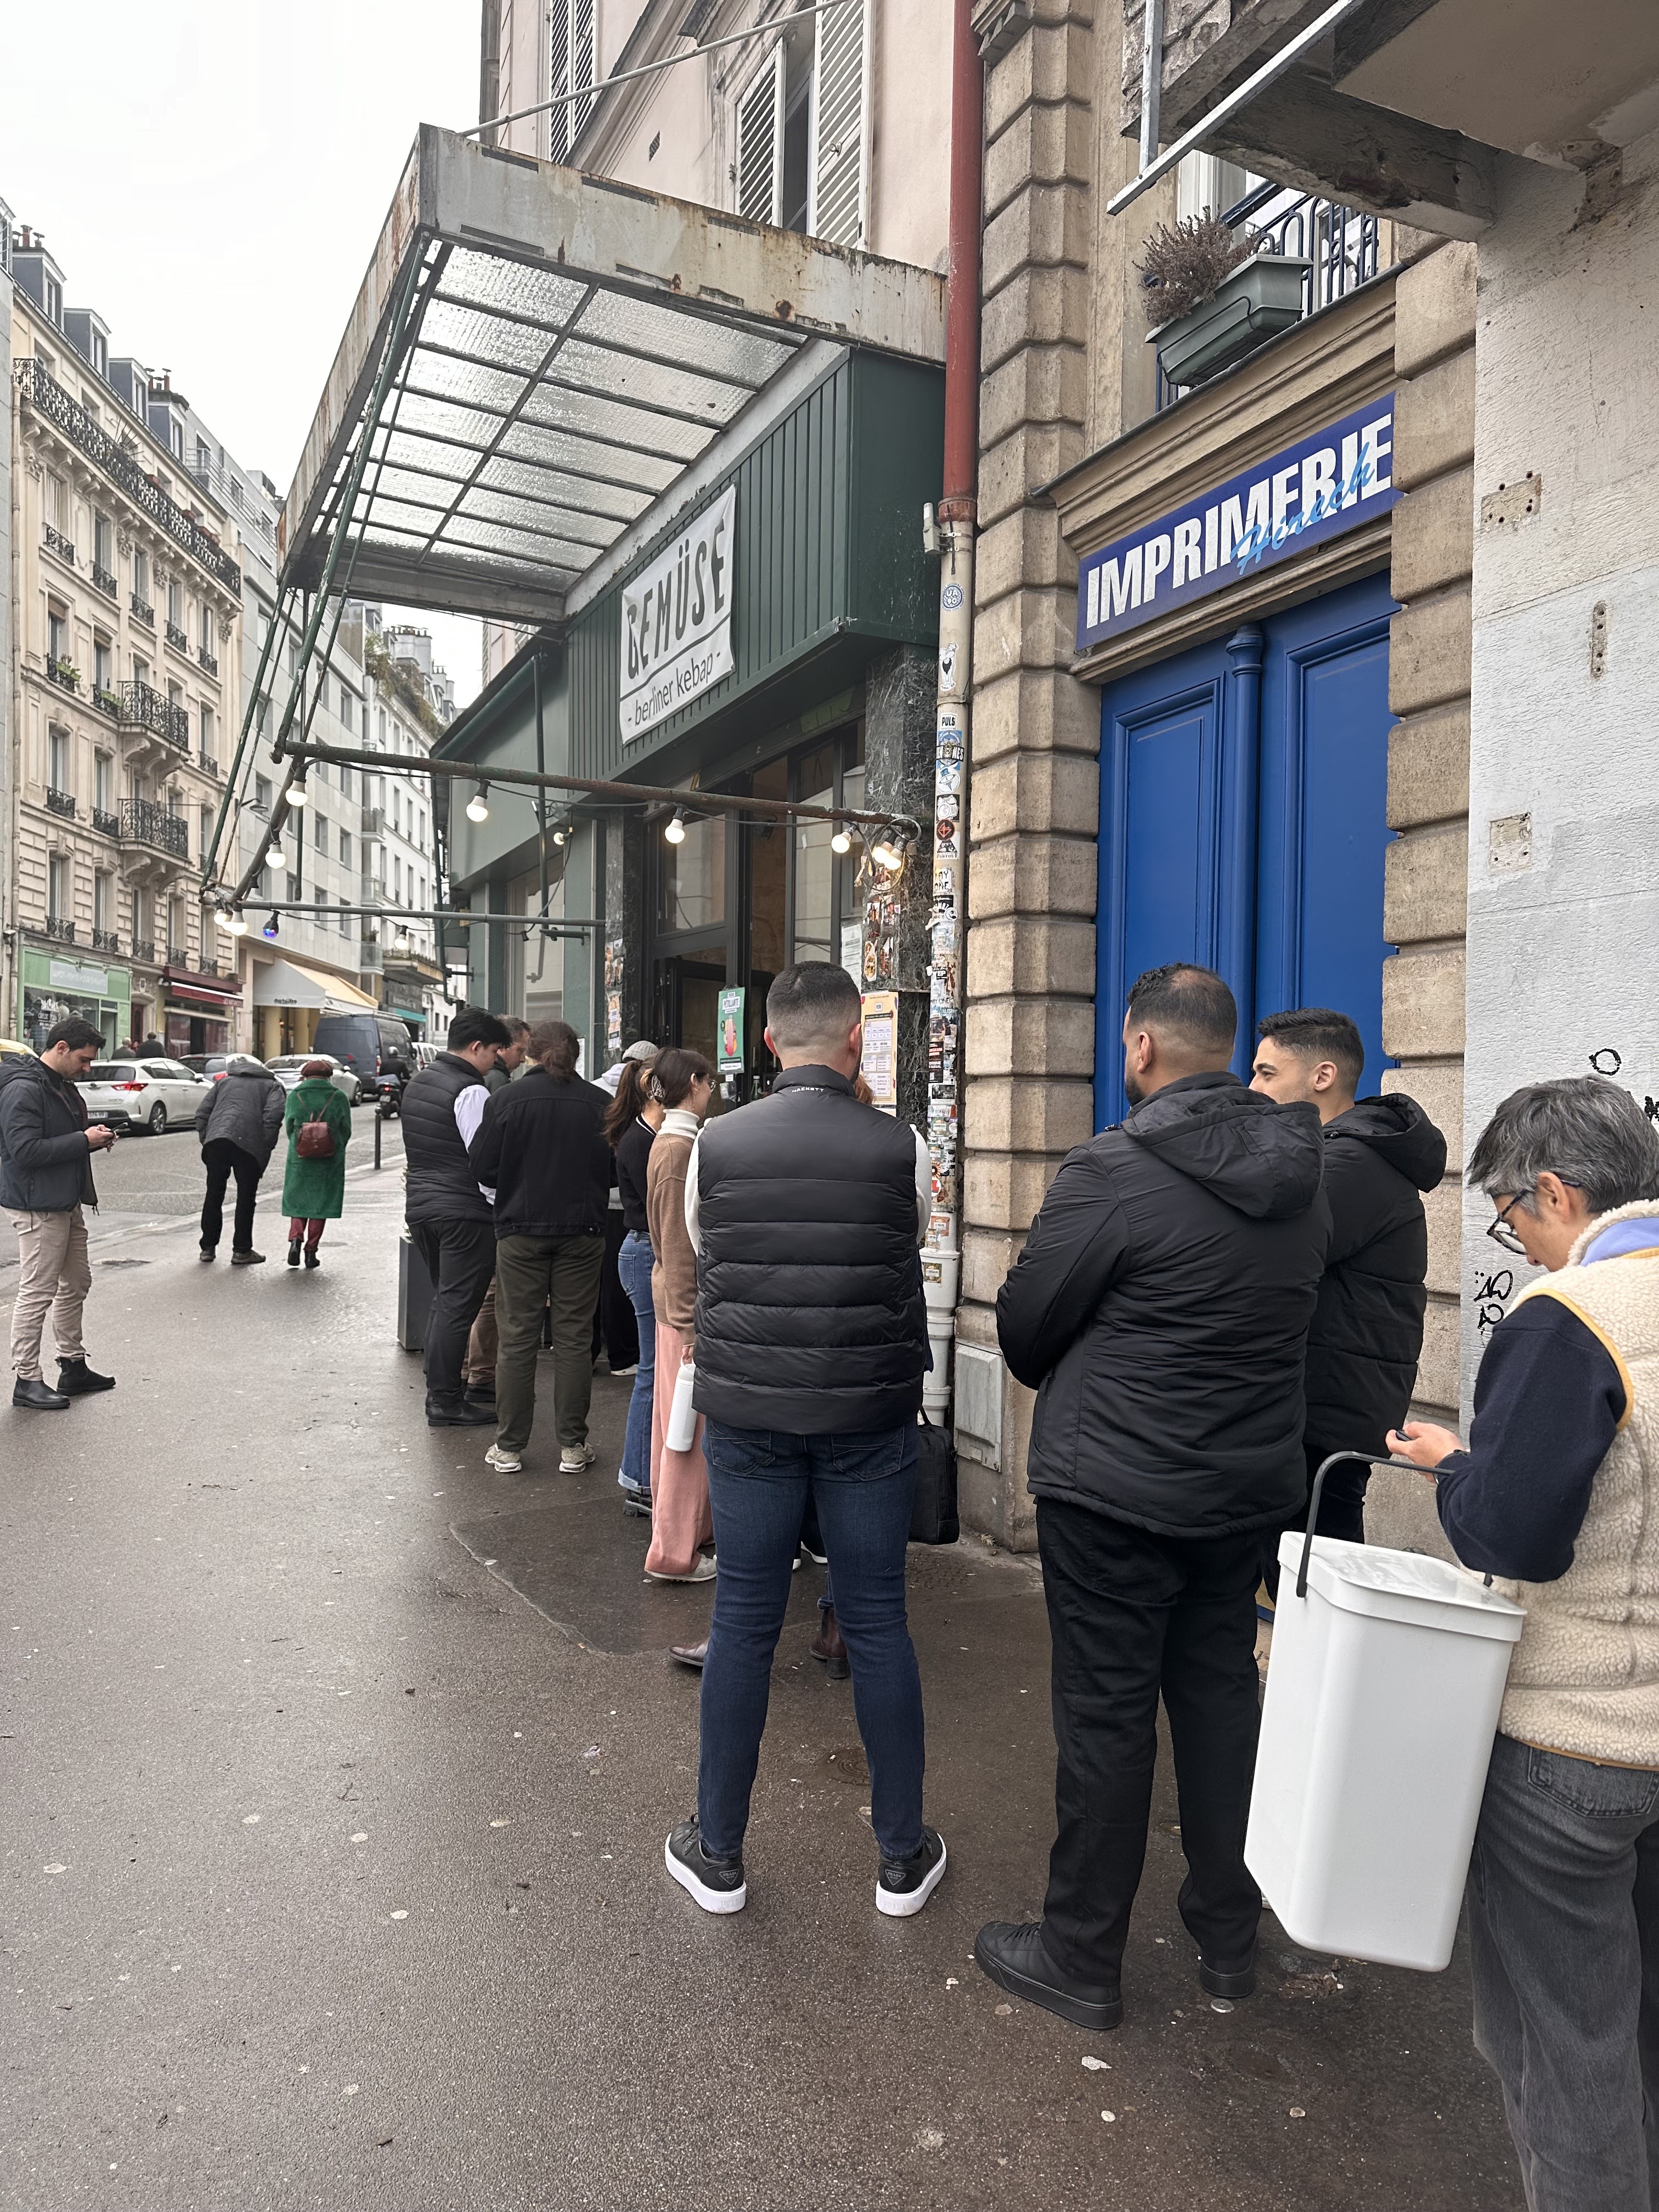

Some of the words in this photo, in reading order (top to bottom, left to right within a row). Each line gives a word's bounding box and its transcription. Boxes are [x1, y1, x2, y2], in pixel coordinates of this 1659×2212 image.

[1087, 413, 1391, 629] IMPRIMERIE
[627, 517, 725, 679] GEMÜSE
[635, 680, 673, 726] berliner
[676, 653, 713, 697] kebap
[941, 716, 955, 726] PULS
